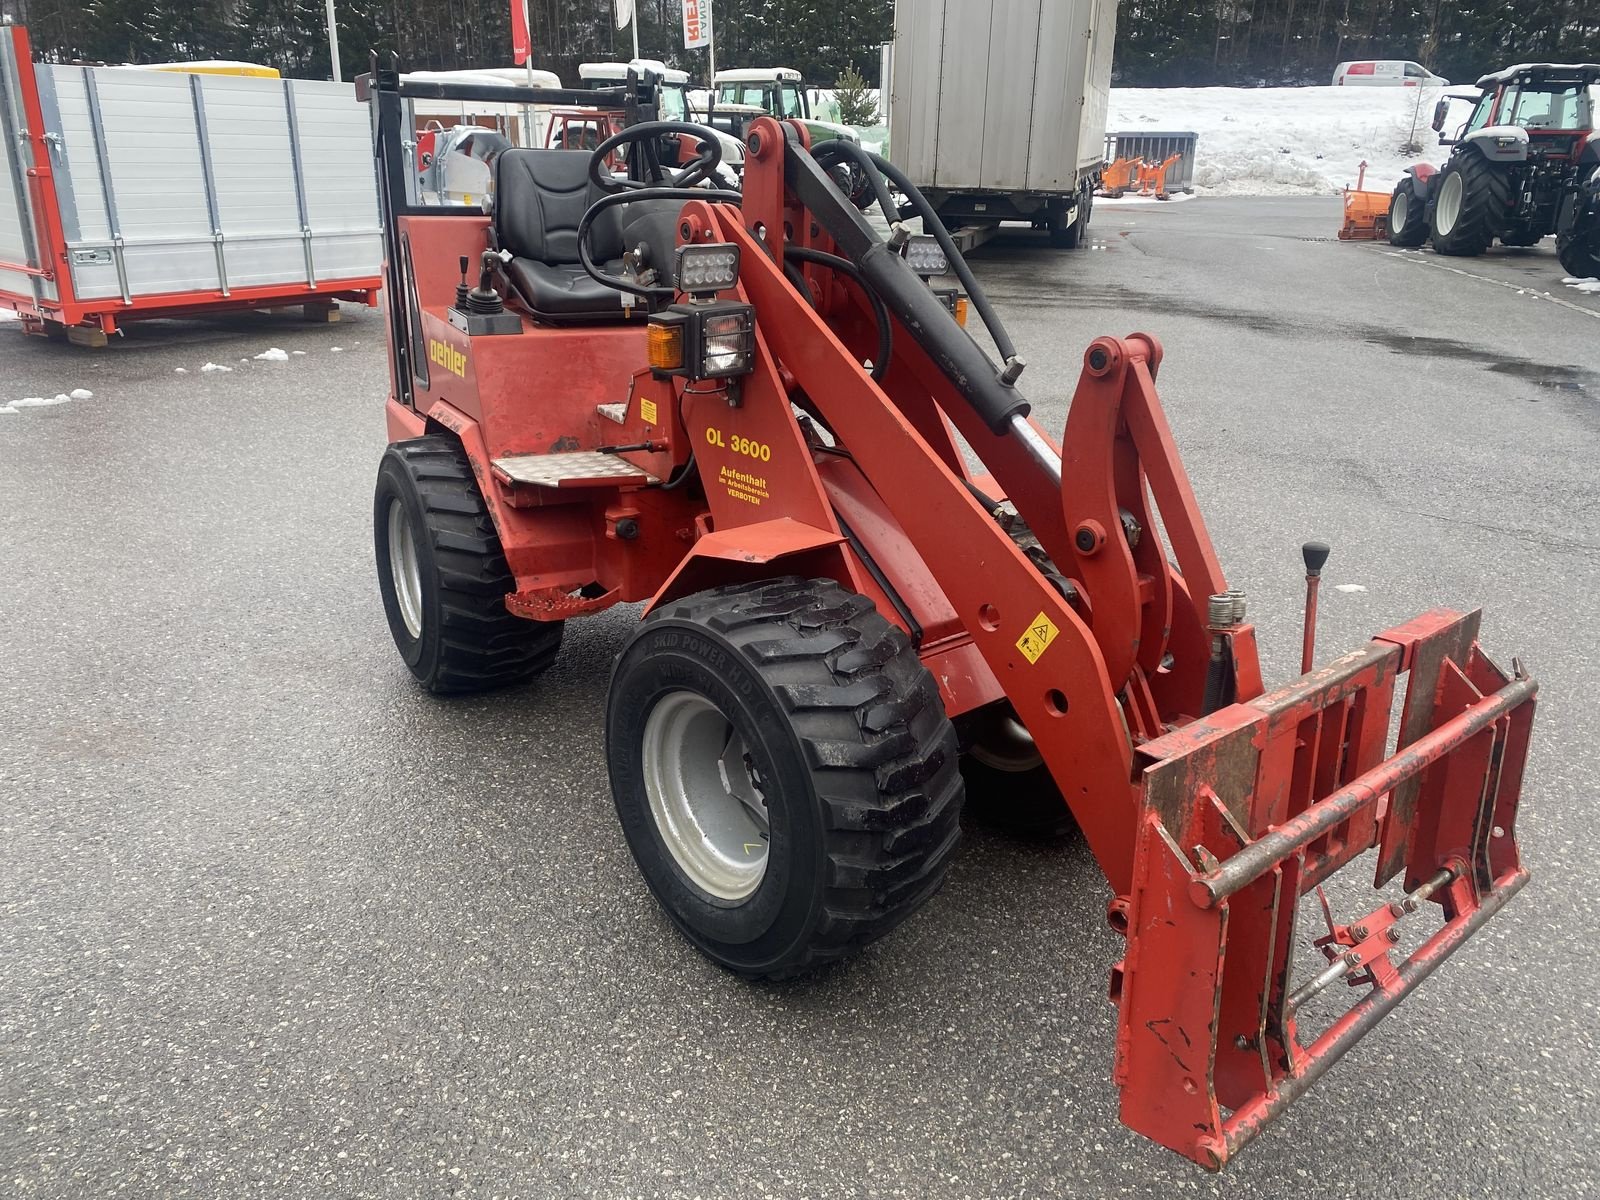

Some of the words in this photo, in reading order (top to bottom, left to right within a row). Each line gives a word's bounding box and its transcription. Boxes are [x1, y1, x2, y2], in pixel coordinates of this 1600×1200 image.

[430, 339, 467, 378] oehler
[706, 427, 725, 448] OL
[731, 434, 771, 462] 3600
[720, 465, 767, 489] Aufenthalt
[727, 479, 769, 498] Arbeitsbereich
[727, 487, 760, 505] VERBOTEN
[654, 633, 678, 649] SKID
[682, 635, 726, 670] POWER
